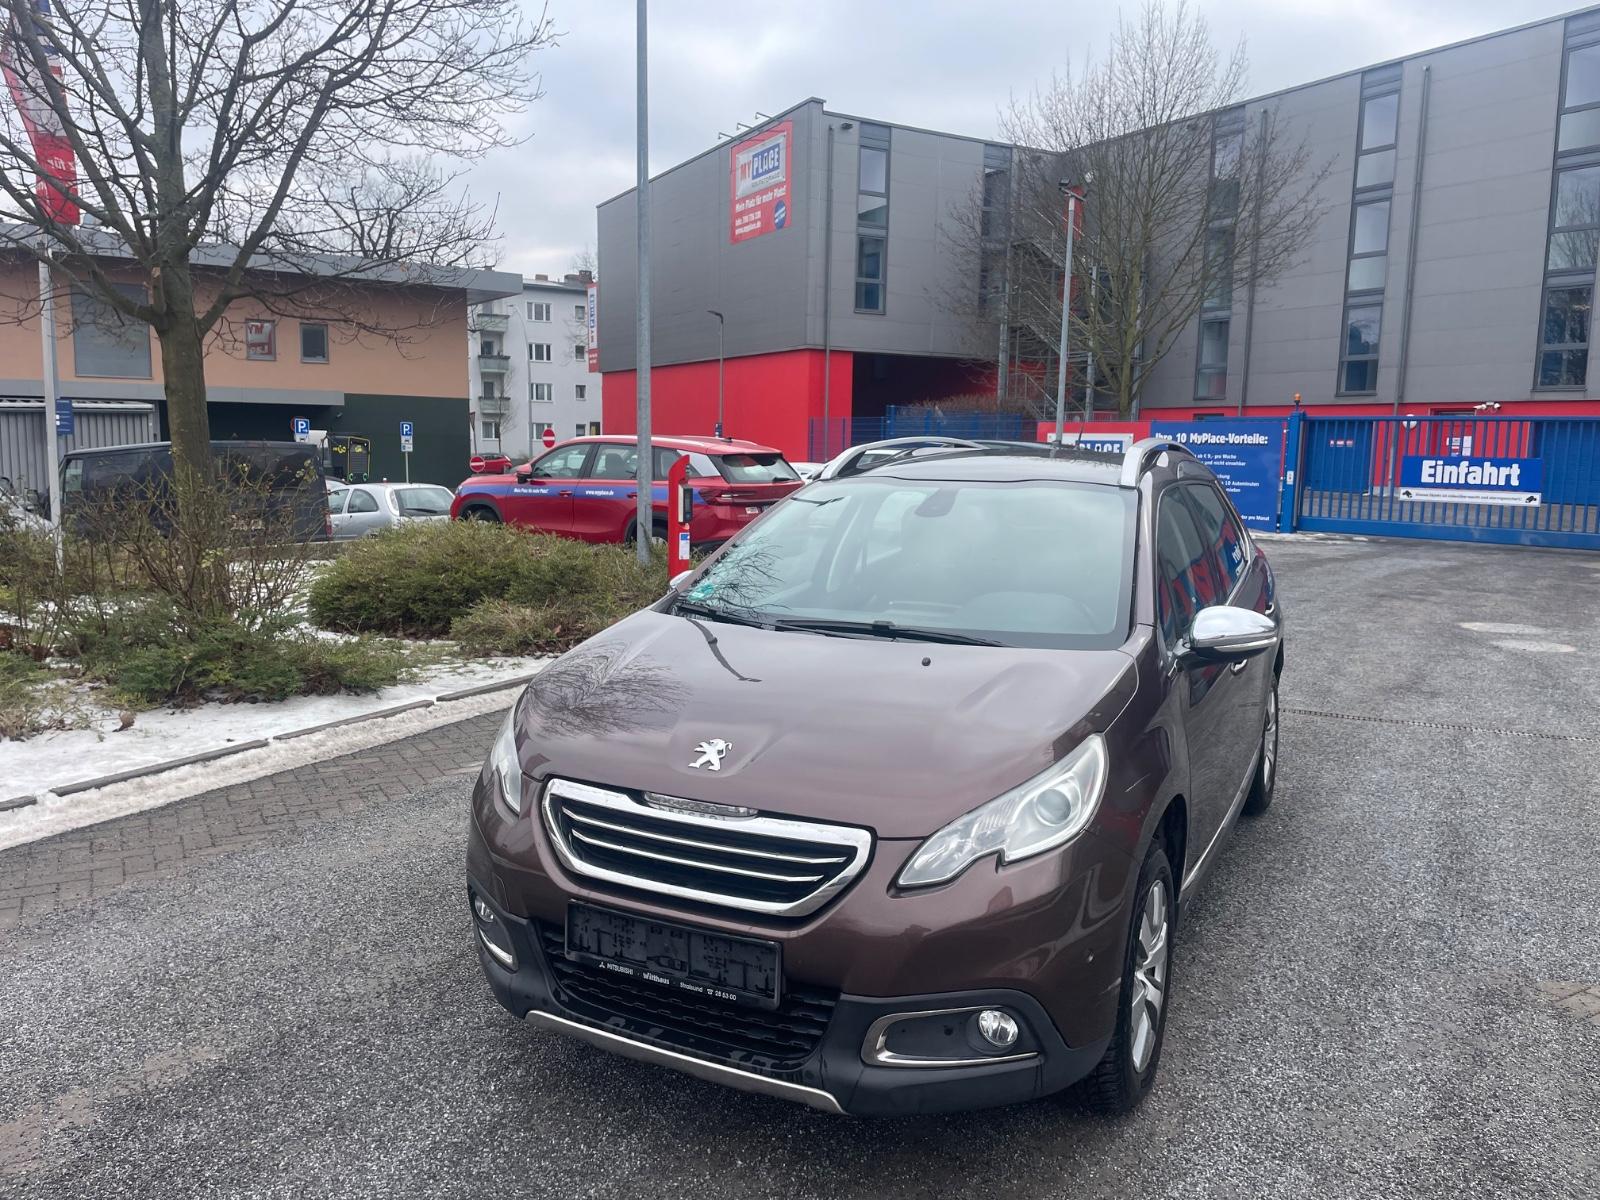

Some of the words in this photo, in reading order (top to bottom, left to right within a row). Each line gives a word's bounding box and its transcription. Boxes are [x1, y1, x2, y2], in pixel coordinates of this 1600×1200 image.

[753, 147, 780, 176] PLACE
[1176, 433, 1187, 443] 10
[1190, 433, 1268, 445] MyPlace-Vorteile:
[1420, 460, 1521, 487] Einfahrt
[606, 962, 634, 976] MITSUBISHI
